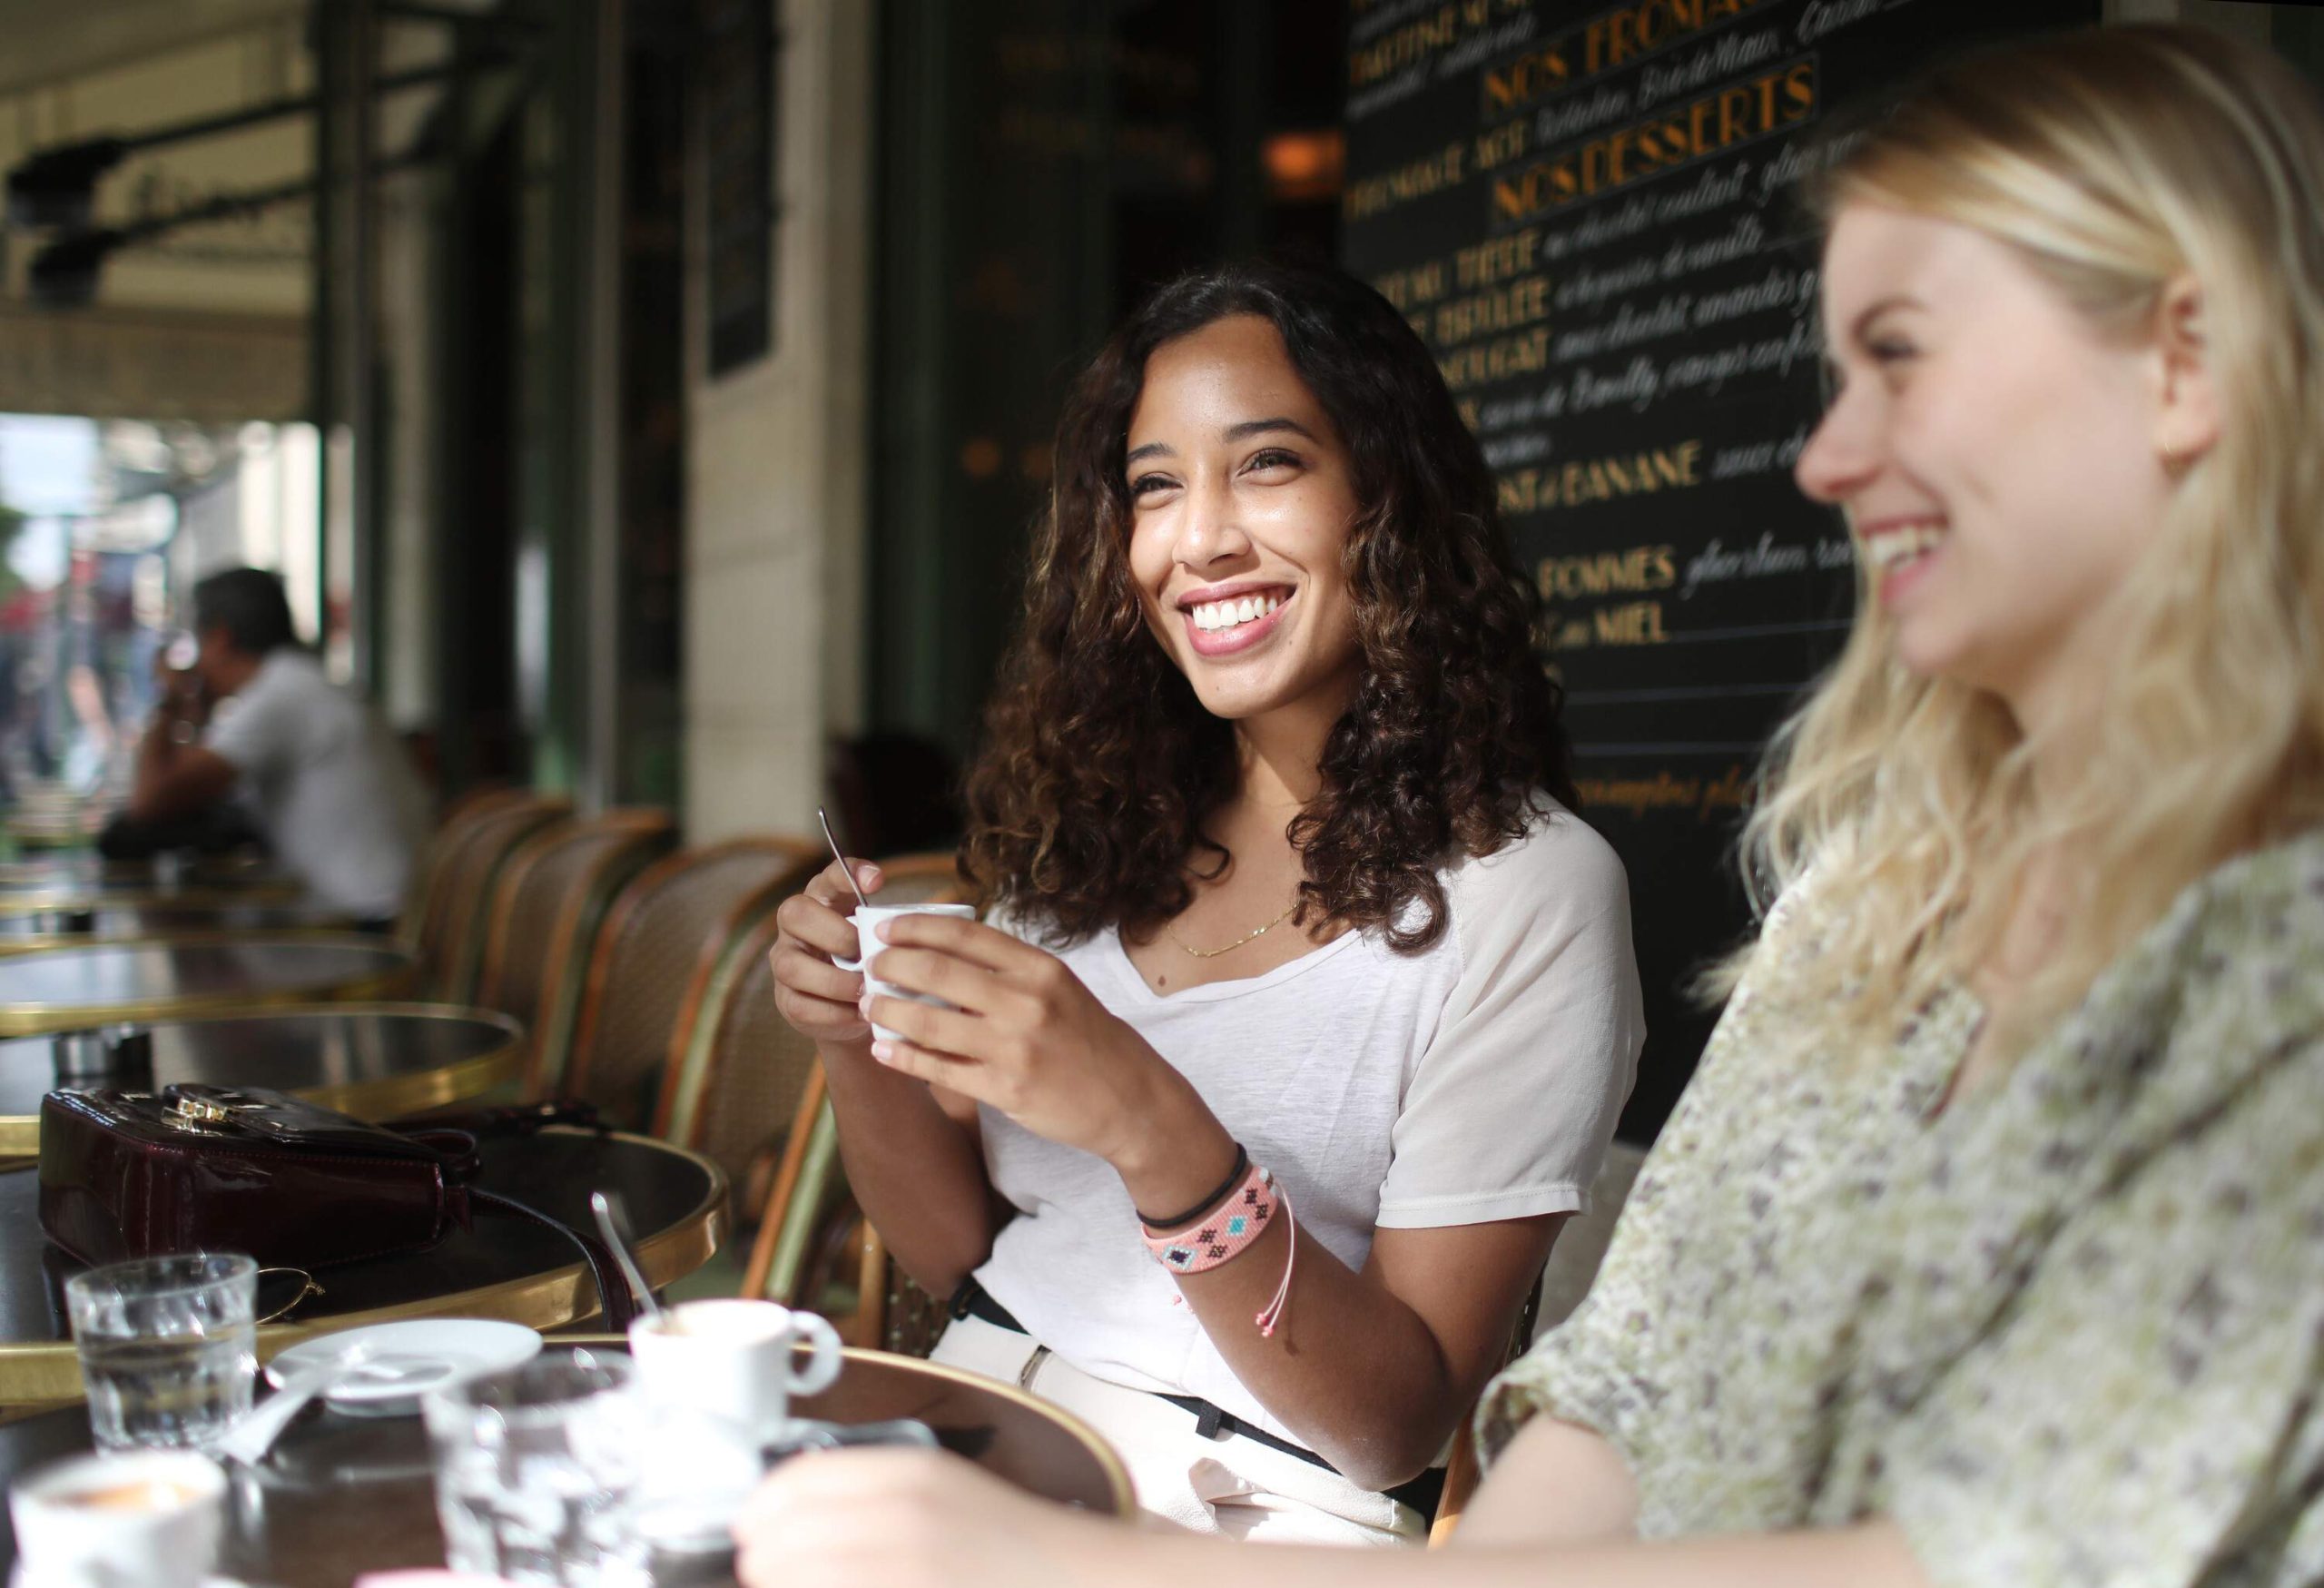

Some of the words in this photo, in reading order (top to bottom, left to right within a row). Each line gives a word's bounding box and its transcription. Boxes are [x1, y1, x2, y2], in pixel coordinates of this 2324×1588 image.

[1482, 44, 1569, 112] NOS
[1583, 0, 1759, 74] FROM
[1493, 153, 1577, 220] NOS
[1581, 62, 1814, 196] DESSERTS
[1561, 438, 1703, 508] BANANE
[1538, 544, 1676, 606] POMMES
[1593, 601, 1671, 648] MIEL
